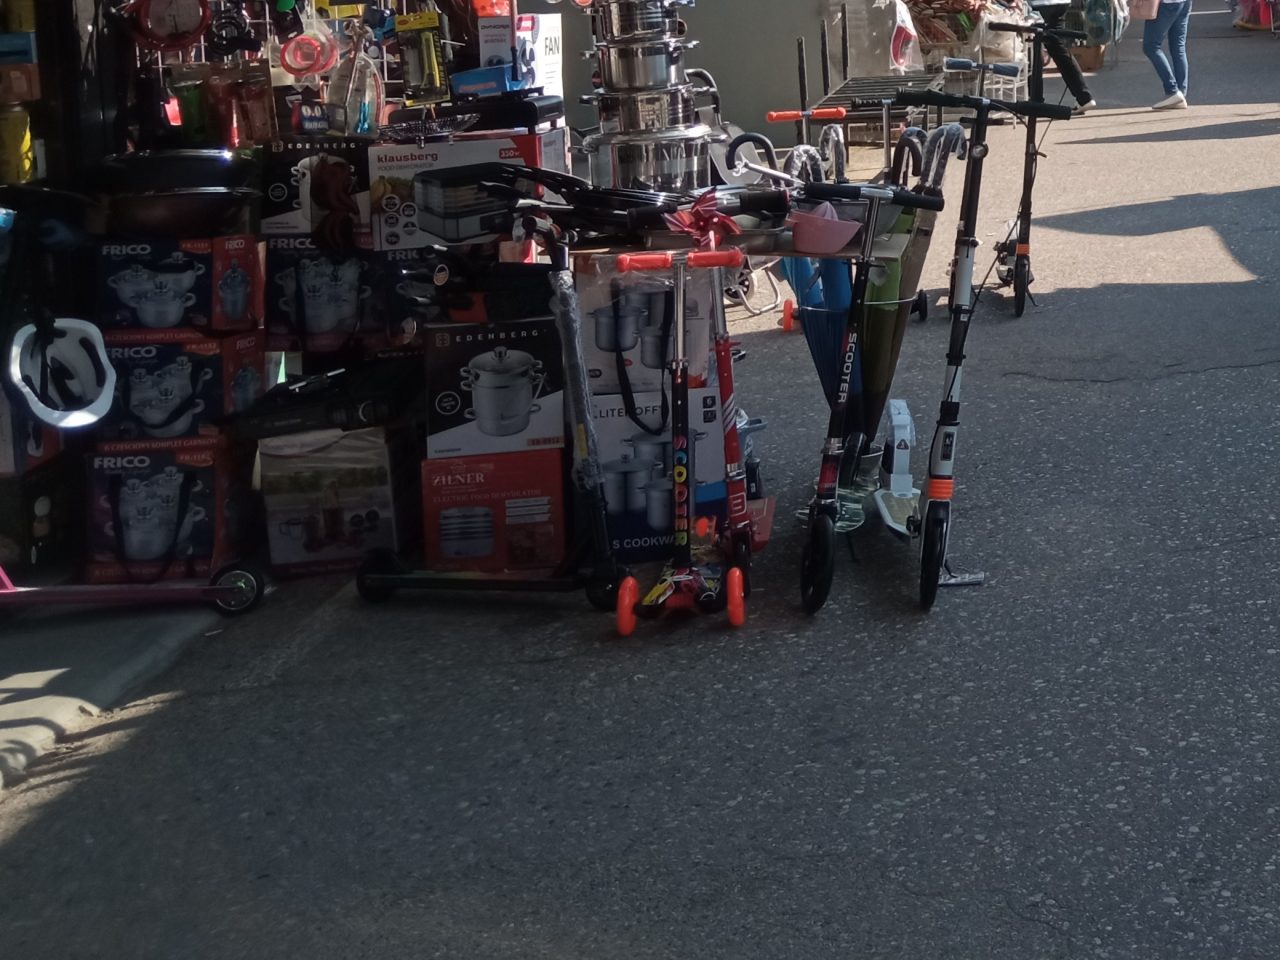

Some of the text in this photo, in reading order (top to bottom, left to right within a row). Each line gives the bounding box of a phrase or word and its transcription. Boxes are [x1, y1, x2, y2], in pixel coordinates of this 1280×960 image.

[544, 36, 560, 56] FAN
[376, 152, 439, 164] klausberg
[102, 243, 152, 256] FRICO
[838, 332, 857, 403] SCOOTER
[93, 456, 151, 469] FRICO
